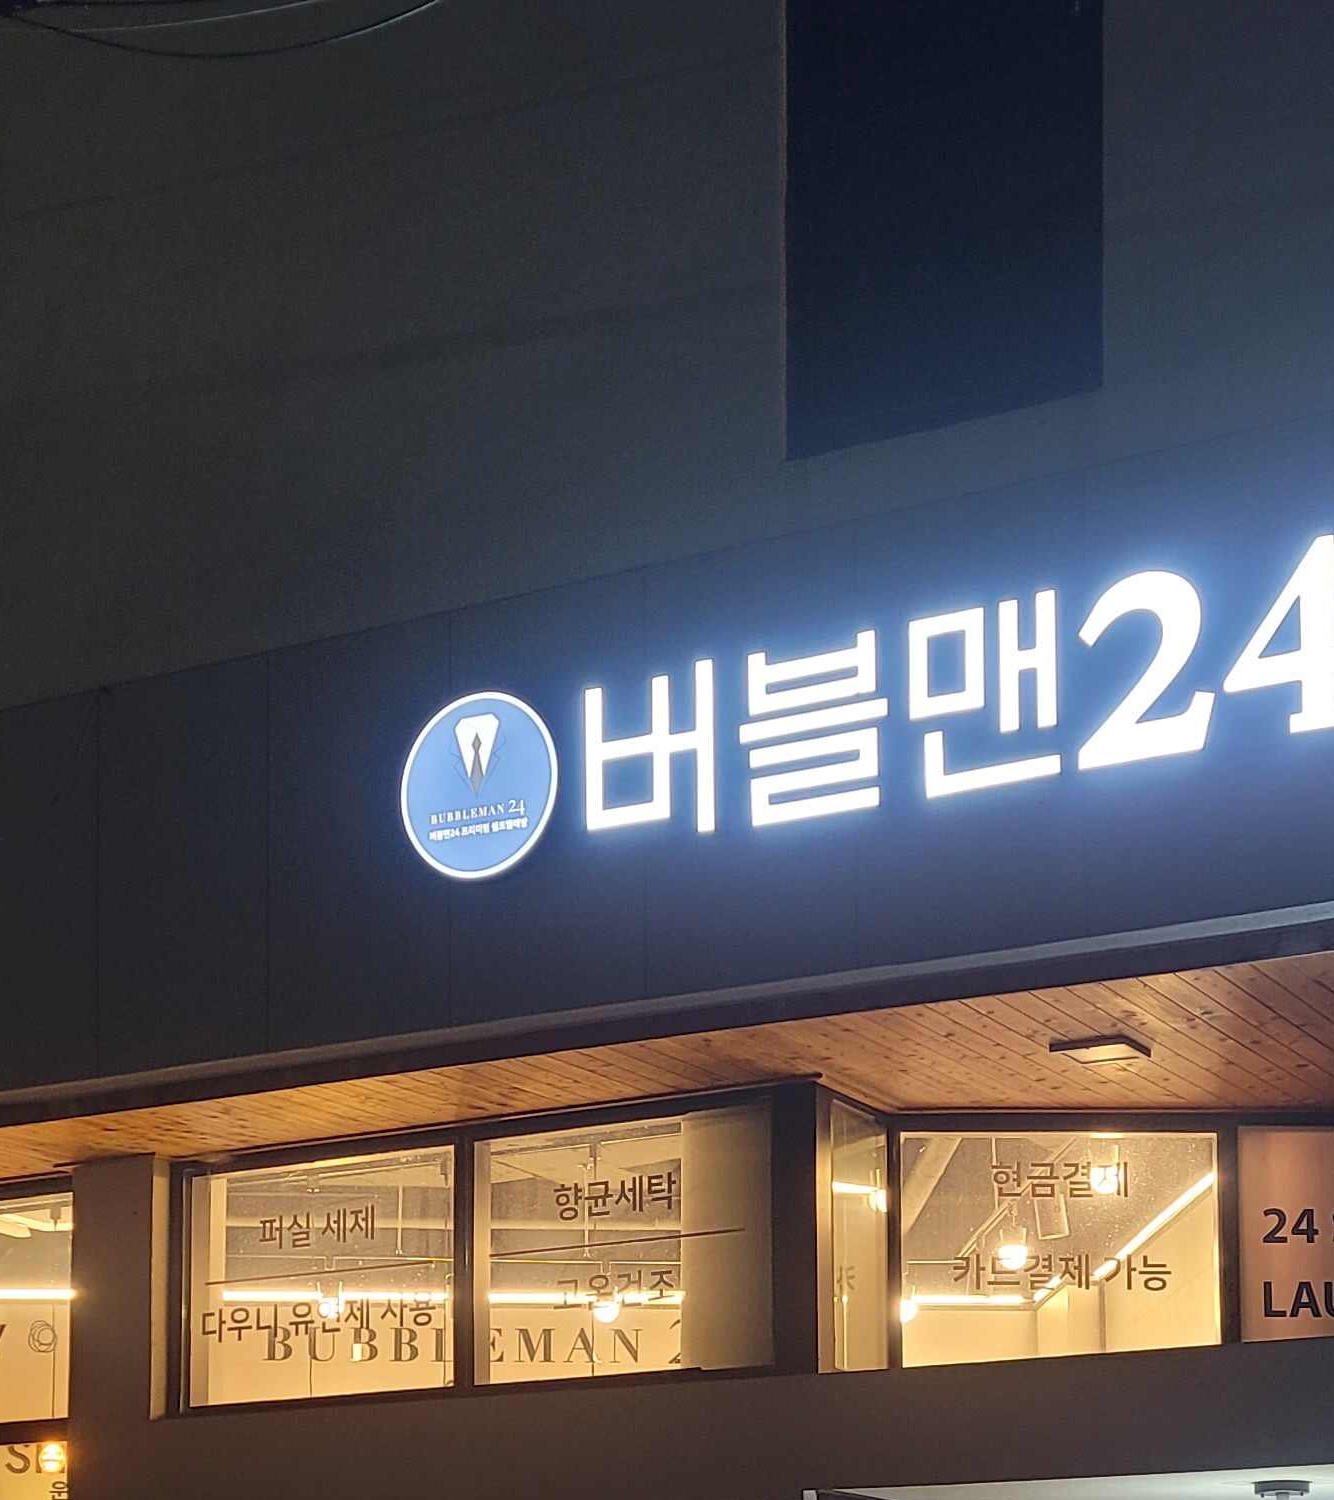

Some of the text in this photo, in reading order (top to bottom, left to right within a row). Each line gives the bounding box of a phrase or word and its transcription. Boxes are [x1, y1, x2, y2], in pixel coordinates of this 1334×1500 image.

[430, 799, 526, 826] BUBBLEMAN 24
[553, 1170, 677, 1222] 향균세탁
[990, 1161, 1130, 1198] 현금결제
[259, 1204, 376, 1249] 퍼실 세제
[1262, 1206, 1319, 1244] 24
[952, 1253, 1173, 1292] 카드결제 가능
[201, 1292, 437, 1343] 다우니 유연제 사용
